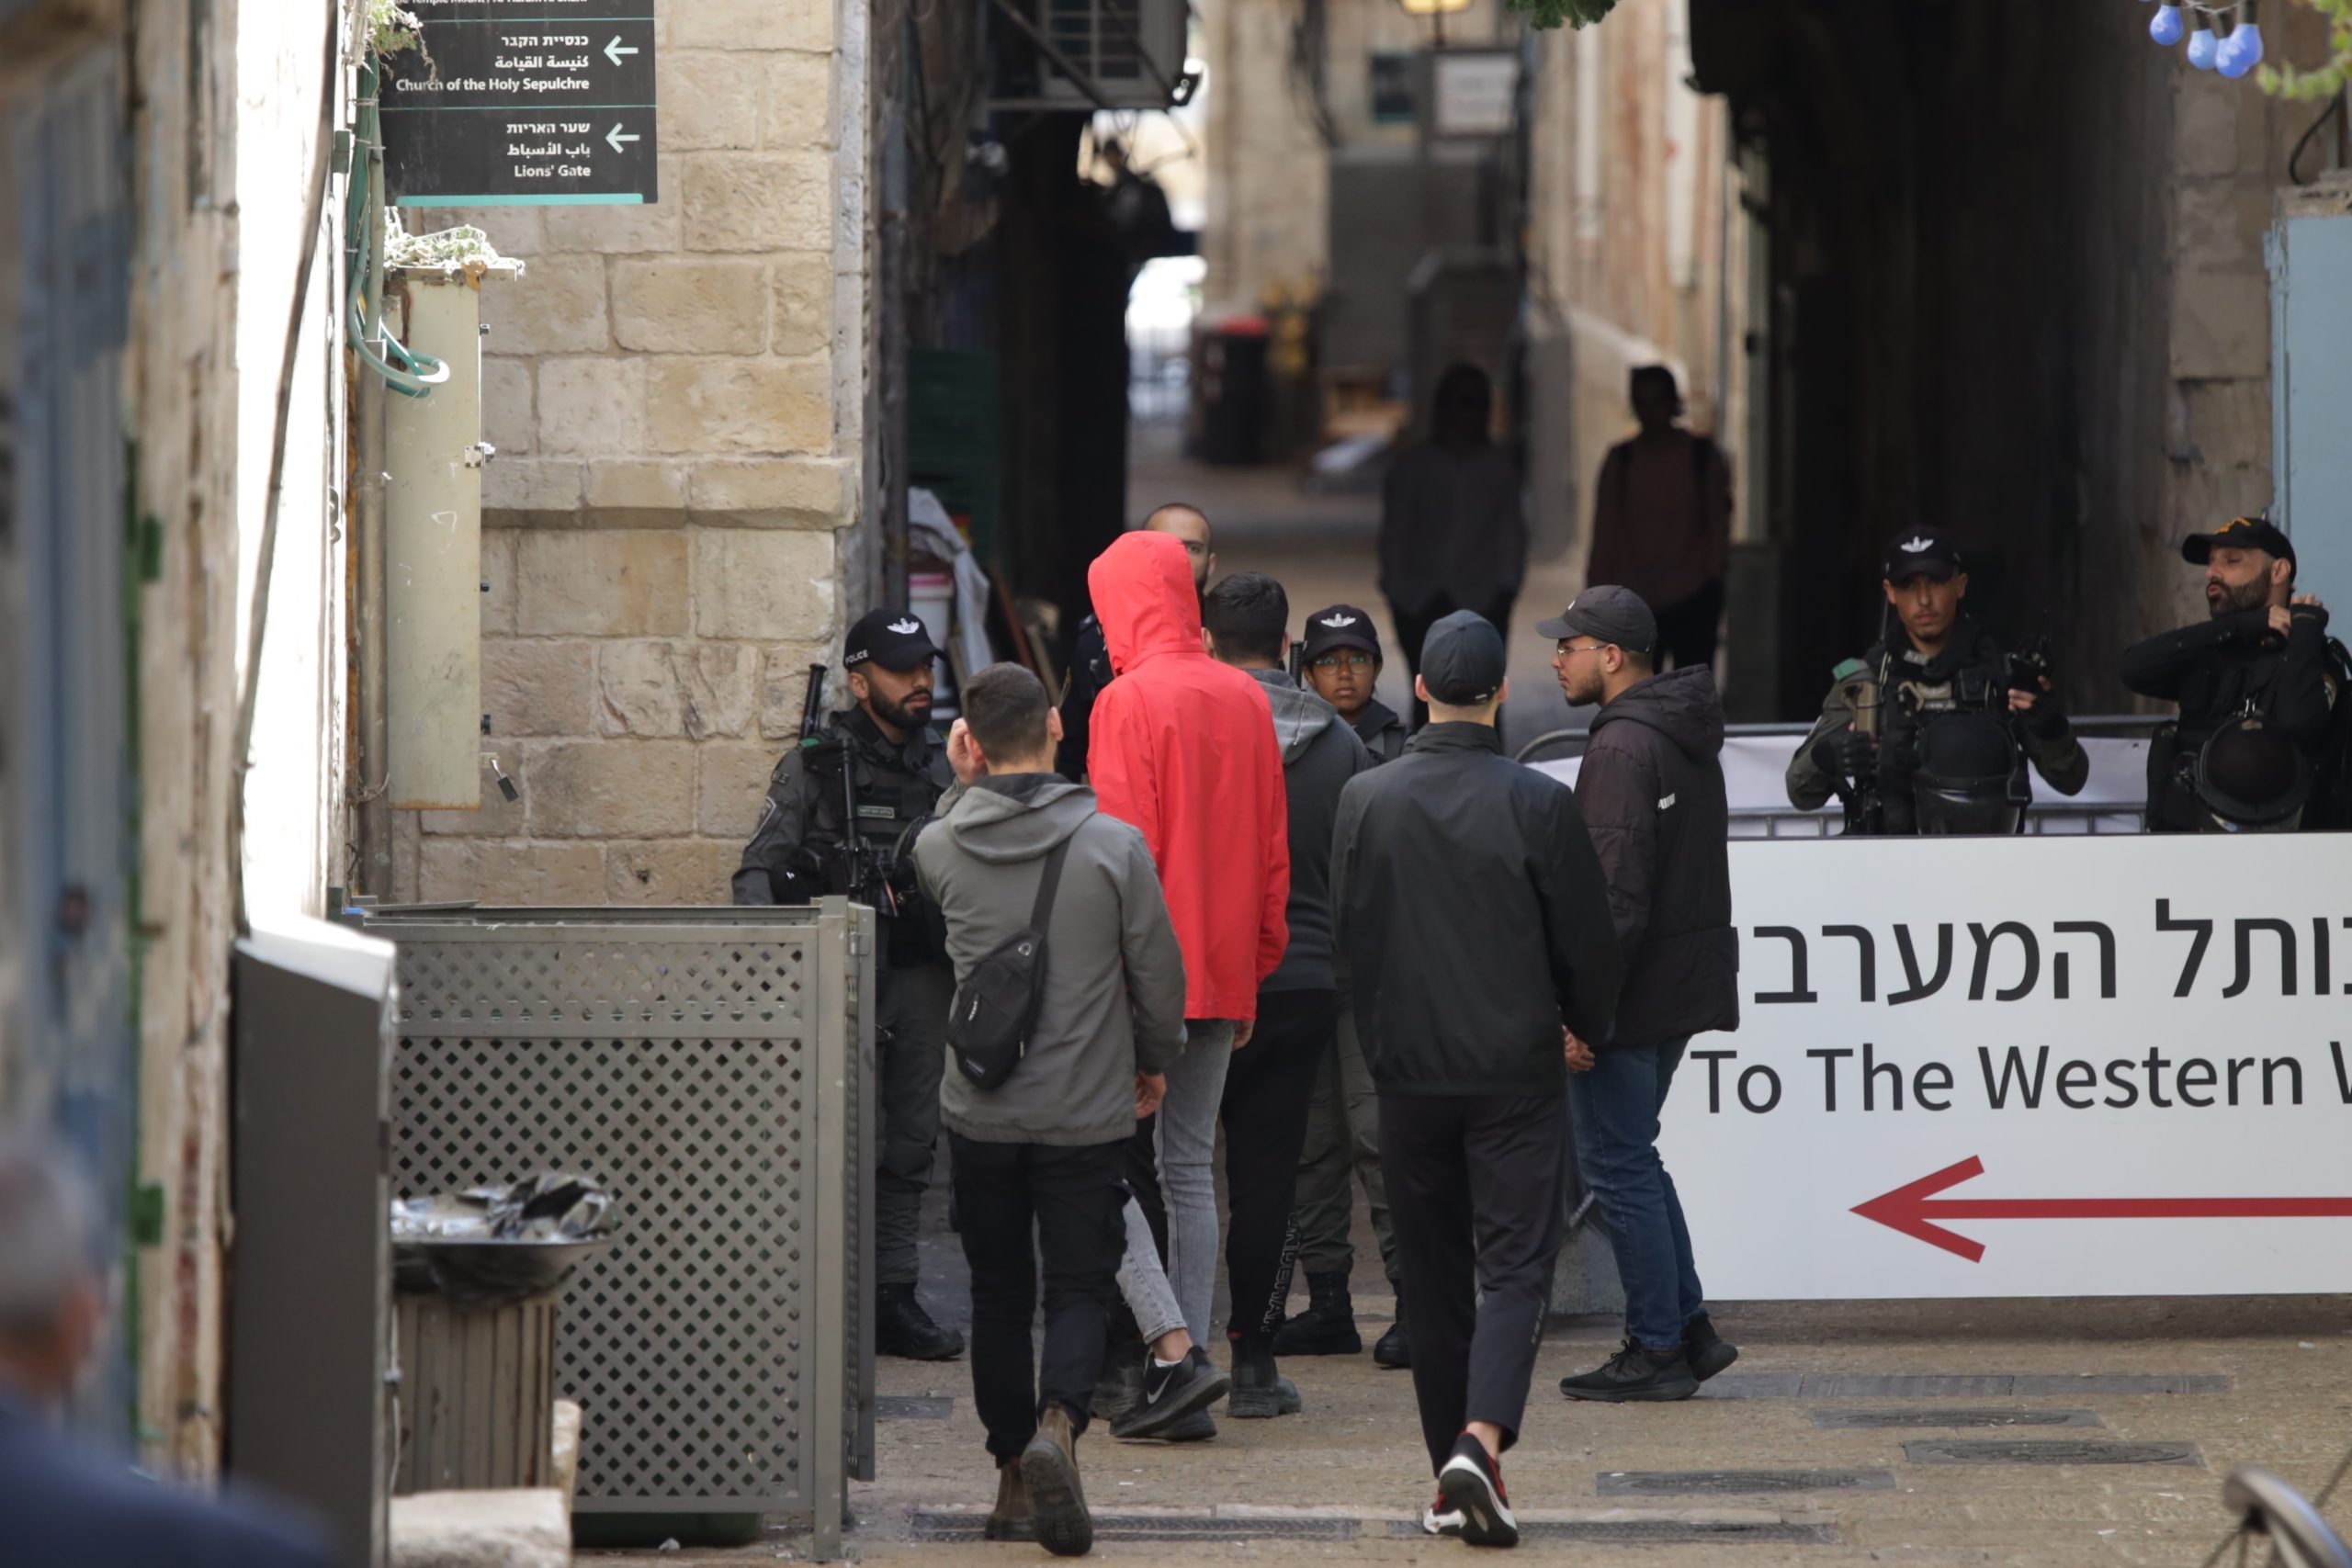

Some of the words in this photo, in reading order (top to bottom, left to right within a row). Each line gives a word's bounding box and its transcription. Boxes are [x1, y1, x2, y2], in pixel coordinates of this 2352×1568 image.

[501, 36, 538, 49] הקבר
[542, 35, 590, 47] כנסיית
[494, 55, 543, 73] القيامة
[546, 54, 590, 72] كنيسة
[395, 77, 444, 92] Church
[446, 77, 462, 91] of
[462, 77, 487, 91] the
[488, 77, 521, 94] Holy
[522, 76, 590, 94] Sepulchre
[506, 123, 557, 134] האריות
[559, 122, 591, 134] שער
[506, 141, 562, 160] الأسباط
[564, 142, 591, 159] باب
[514, 164, 555, 177] Lions'
[558, 164, 592, 177] Gate
[2155, 898, 2352, 999] ותל
[1690, 1049, 1782, 1114] To
[1806, 1043, 1954, 1112] The
[1977, 1045, 2303, 1110] Western
